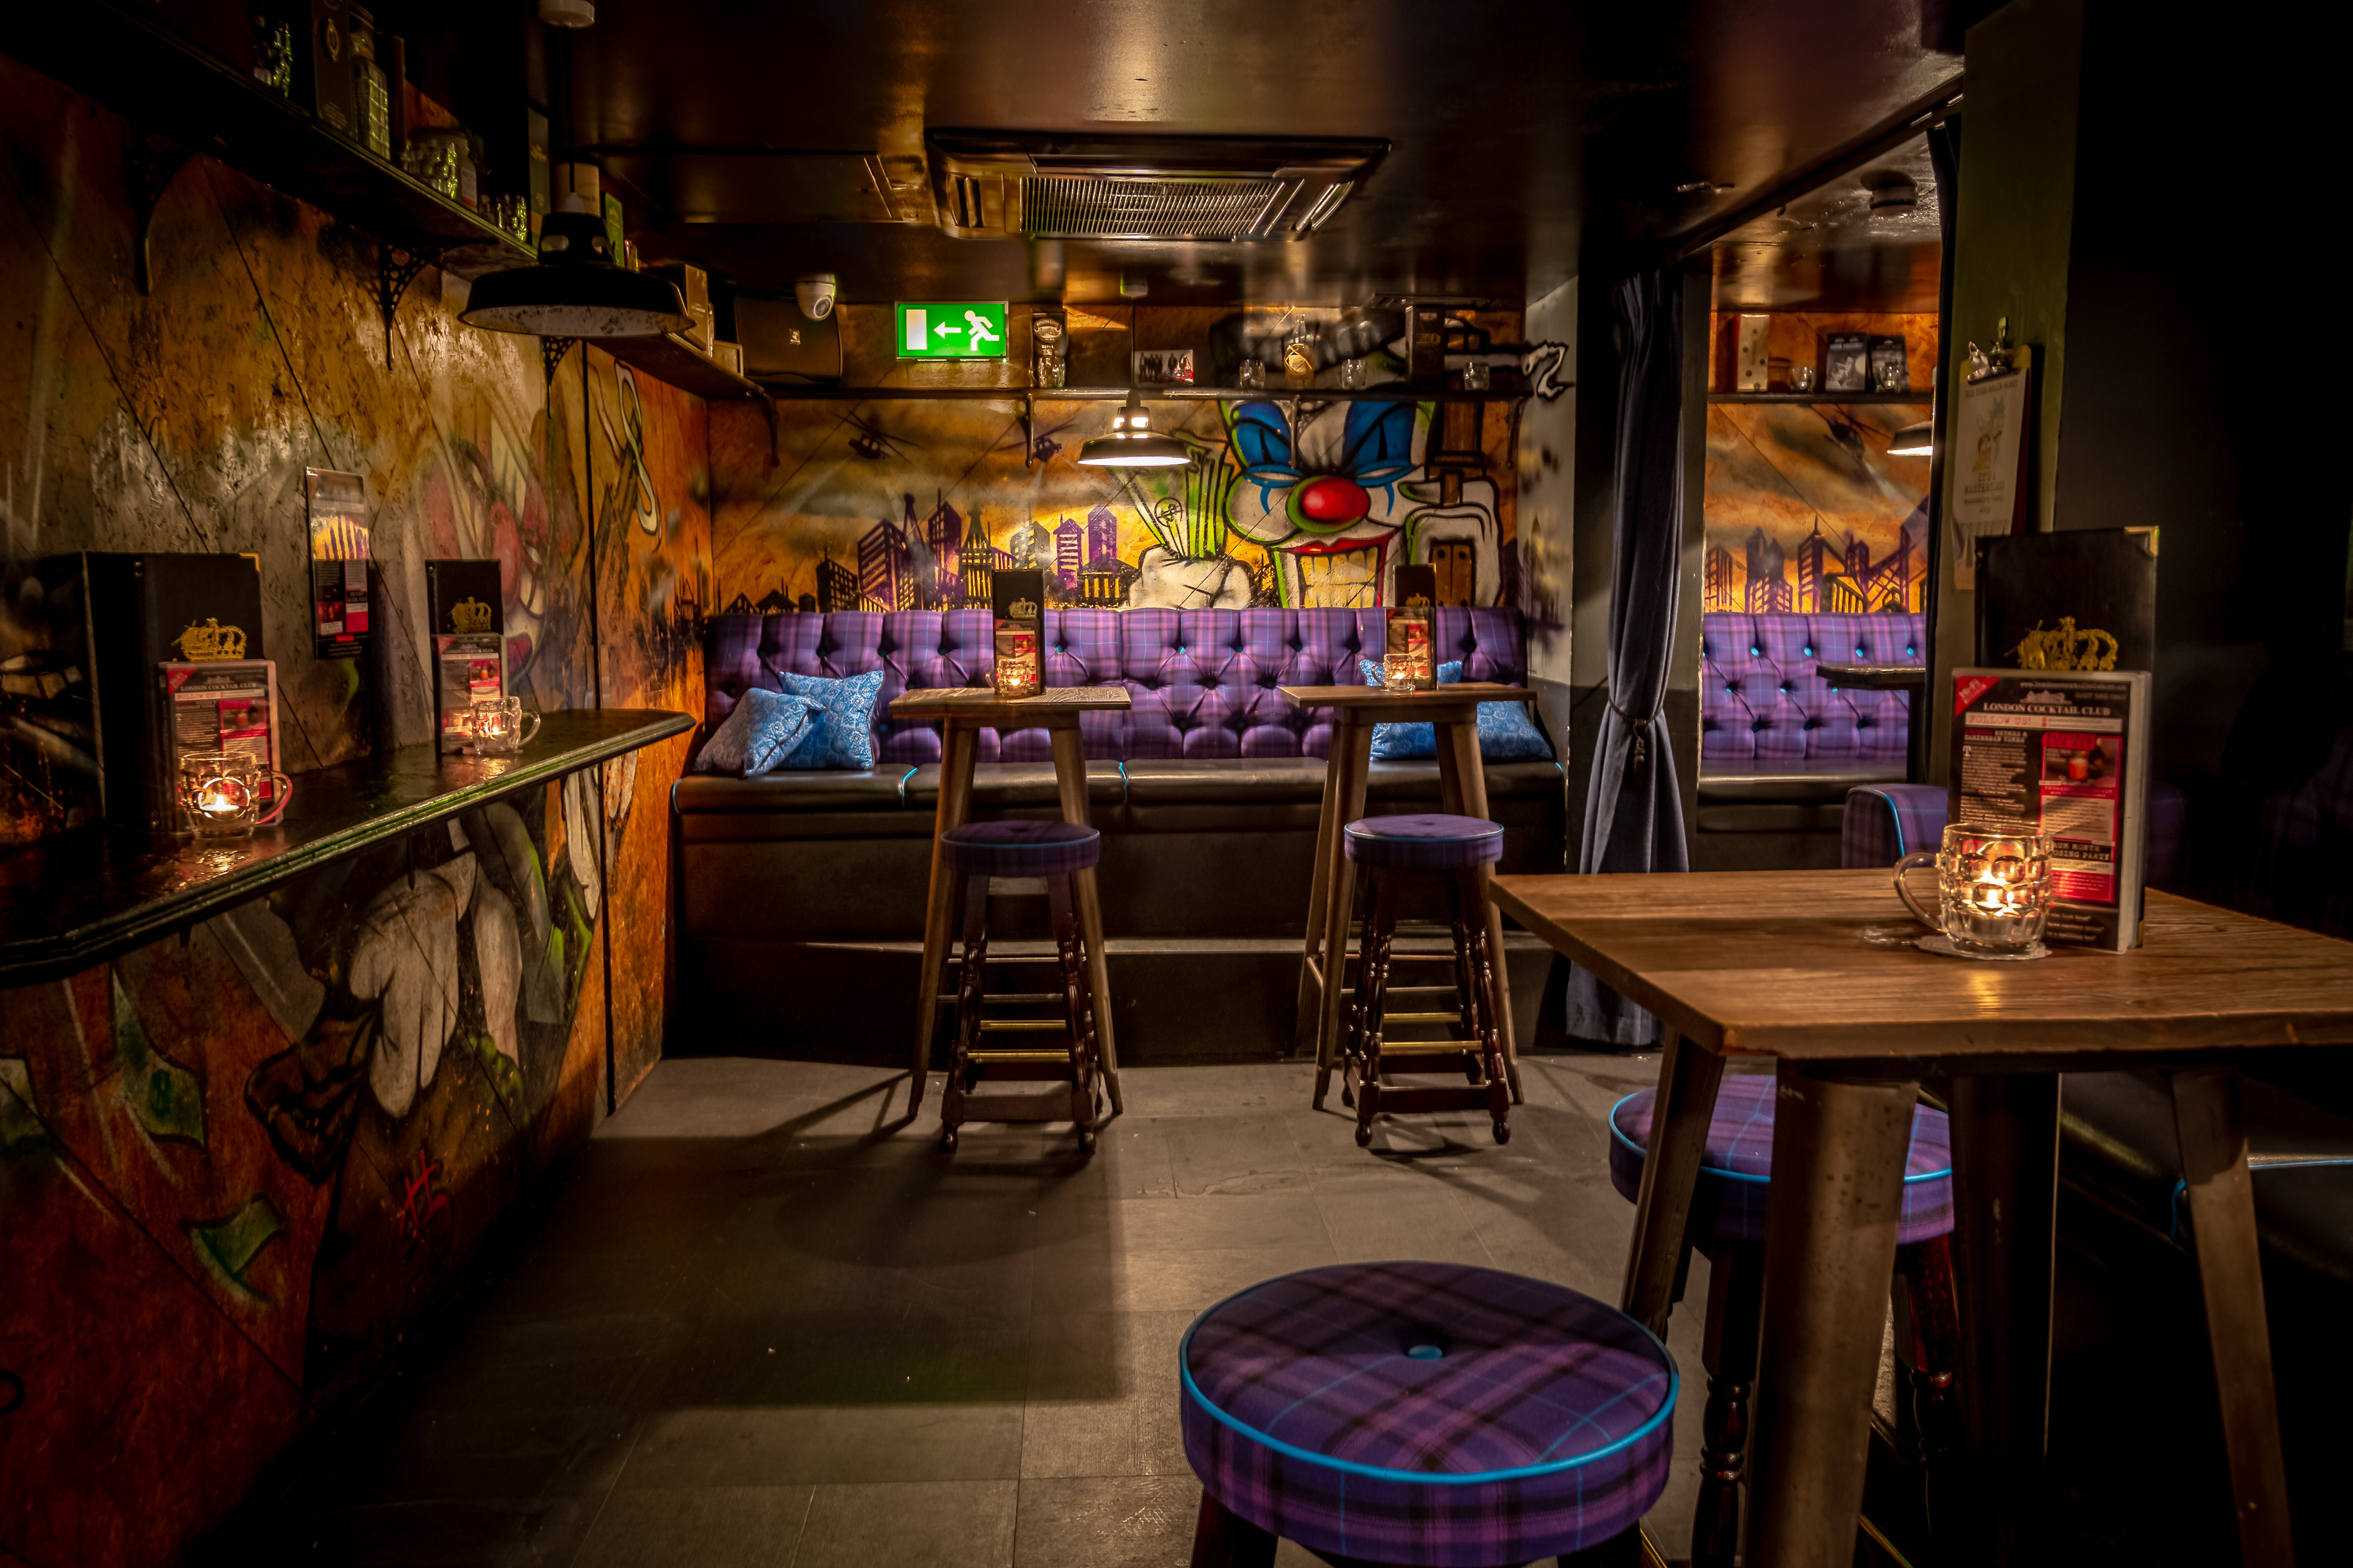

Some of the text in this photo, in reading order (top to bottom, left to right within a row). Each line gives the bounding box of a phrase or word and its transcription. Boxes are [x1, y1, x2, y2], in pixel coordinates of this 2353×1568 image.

[1984, 702, 2111, 716] LONDON COCKTAIL CLUB
[1969, 715, 2031, 726] FOLLOW US!
[2072, 843, 2100, 852] MONTH
[2052, 850, 2110, 860] OSING PARTY
